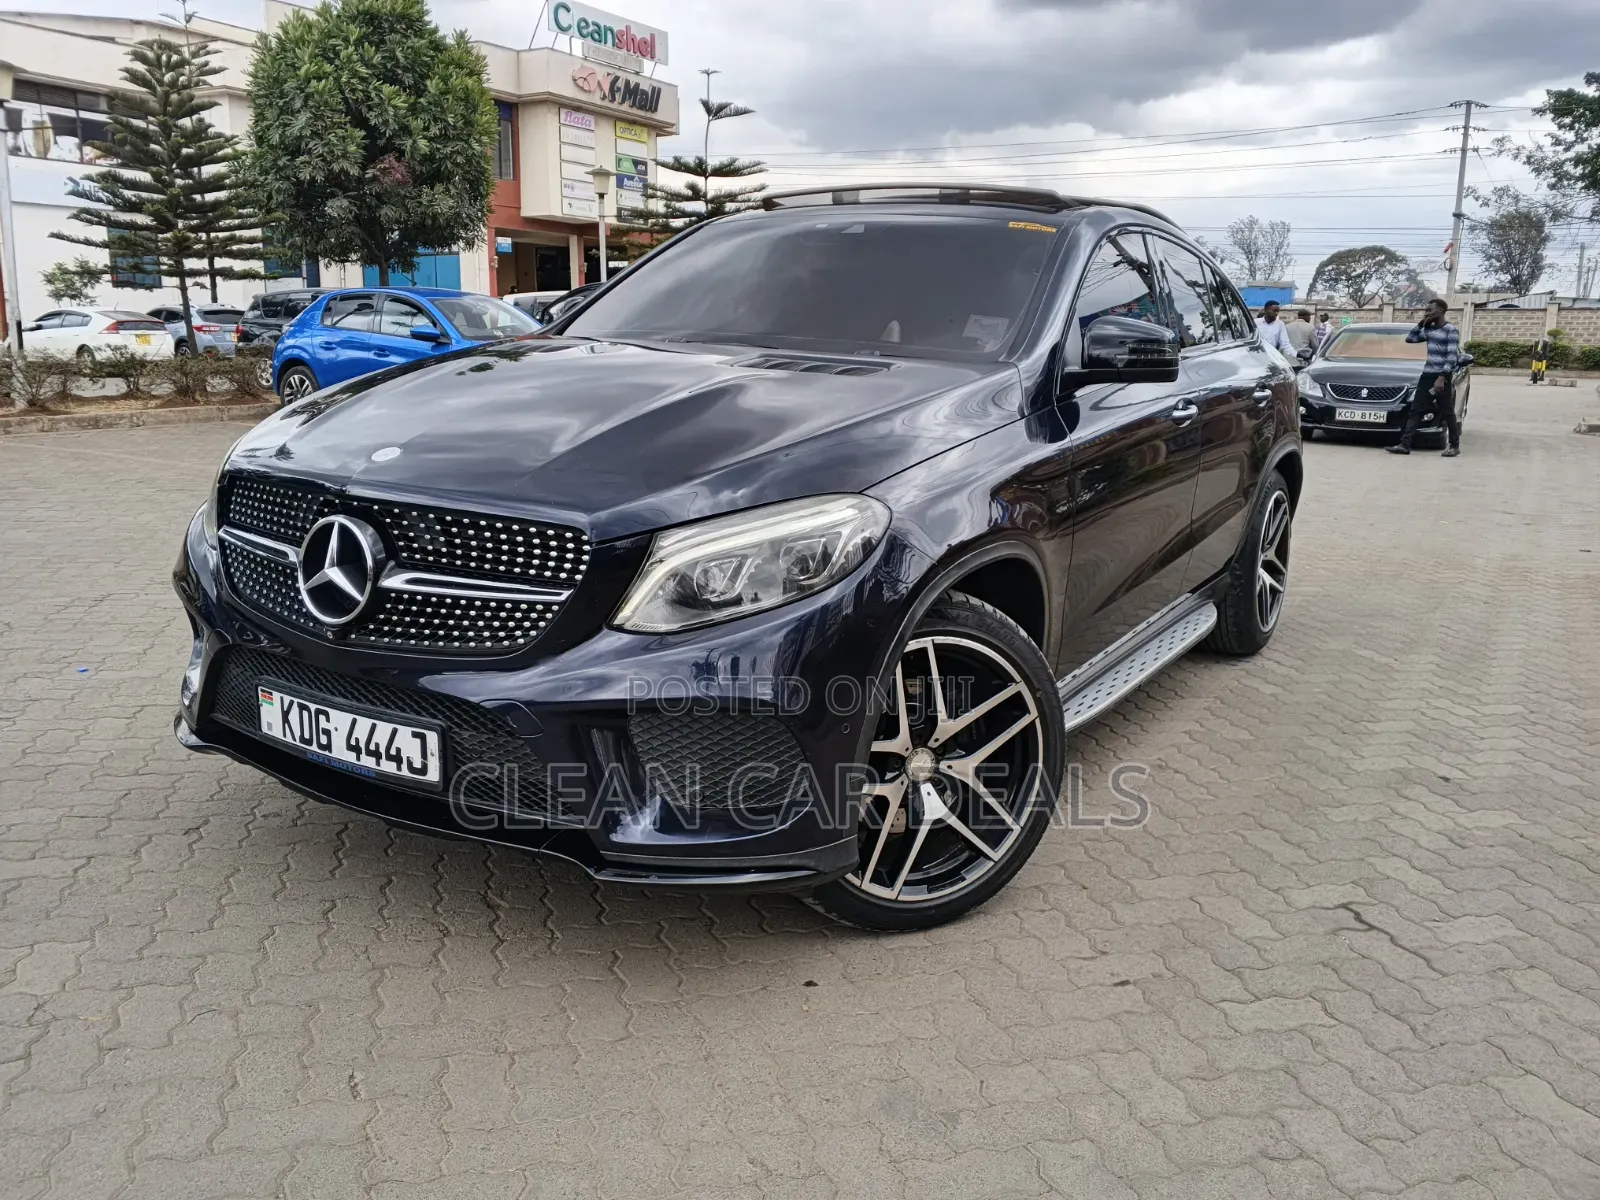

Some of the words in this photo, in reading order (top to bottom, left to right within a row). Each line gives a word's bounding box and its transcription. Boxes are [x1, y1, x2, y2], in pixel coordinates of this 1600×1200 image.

[563, 110, 592, 128] Bata
[1337, 410, 1356, 420] KCD
[1360, 411, 1386, 421] 815H
[279, 695, 333, 754] KDG
[345, 717, 428, 777] 444J
[330, 759, 377, 778] MOTORS
